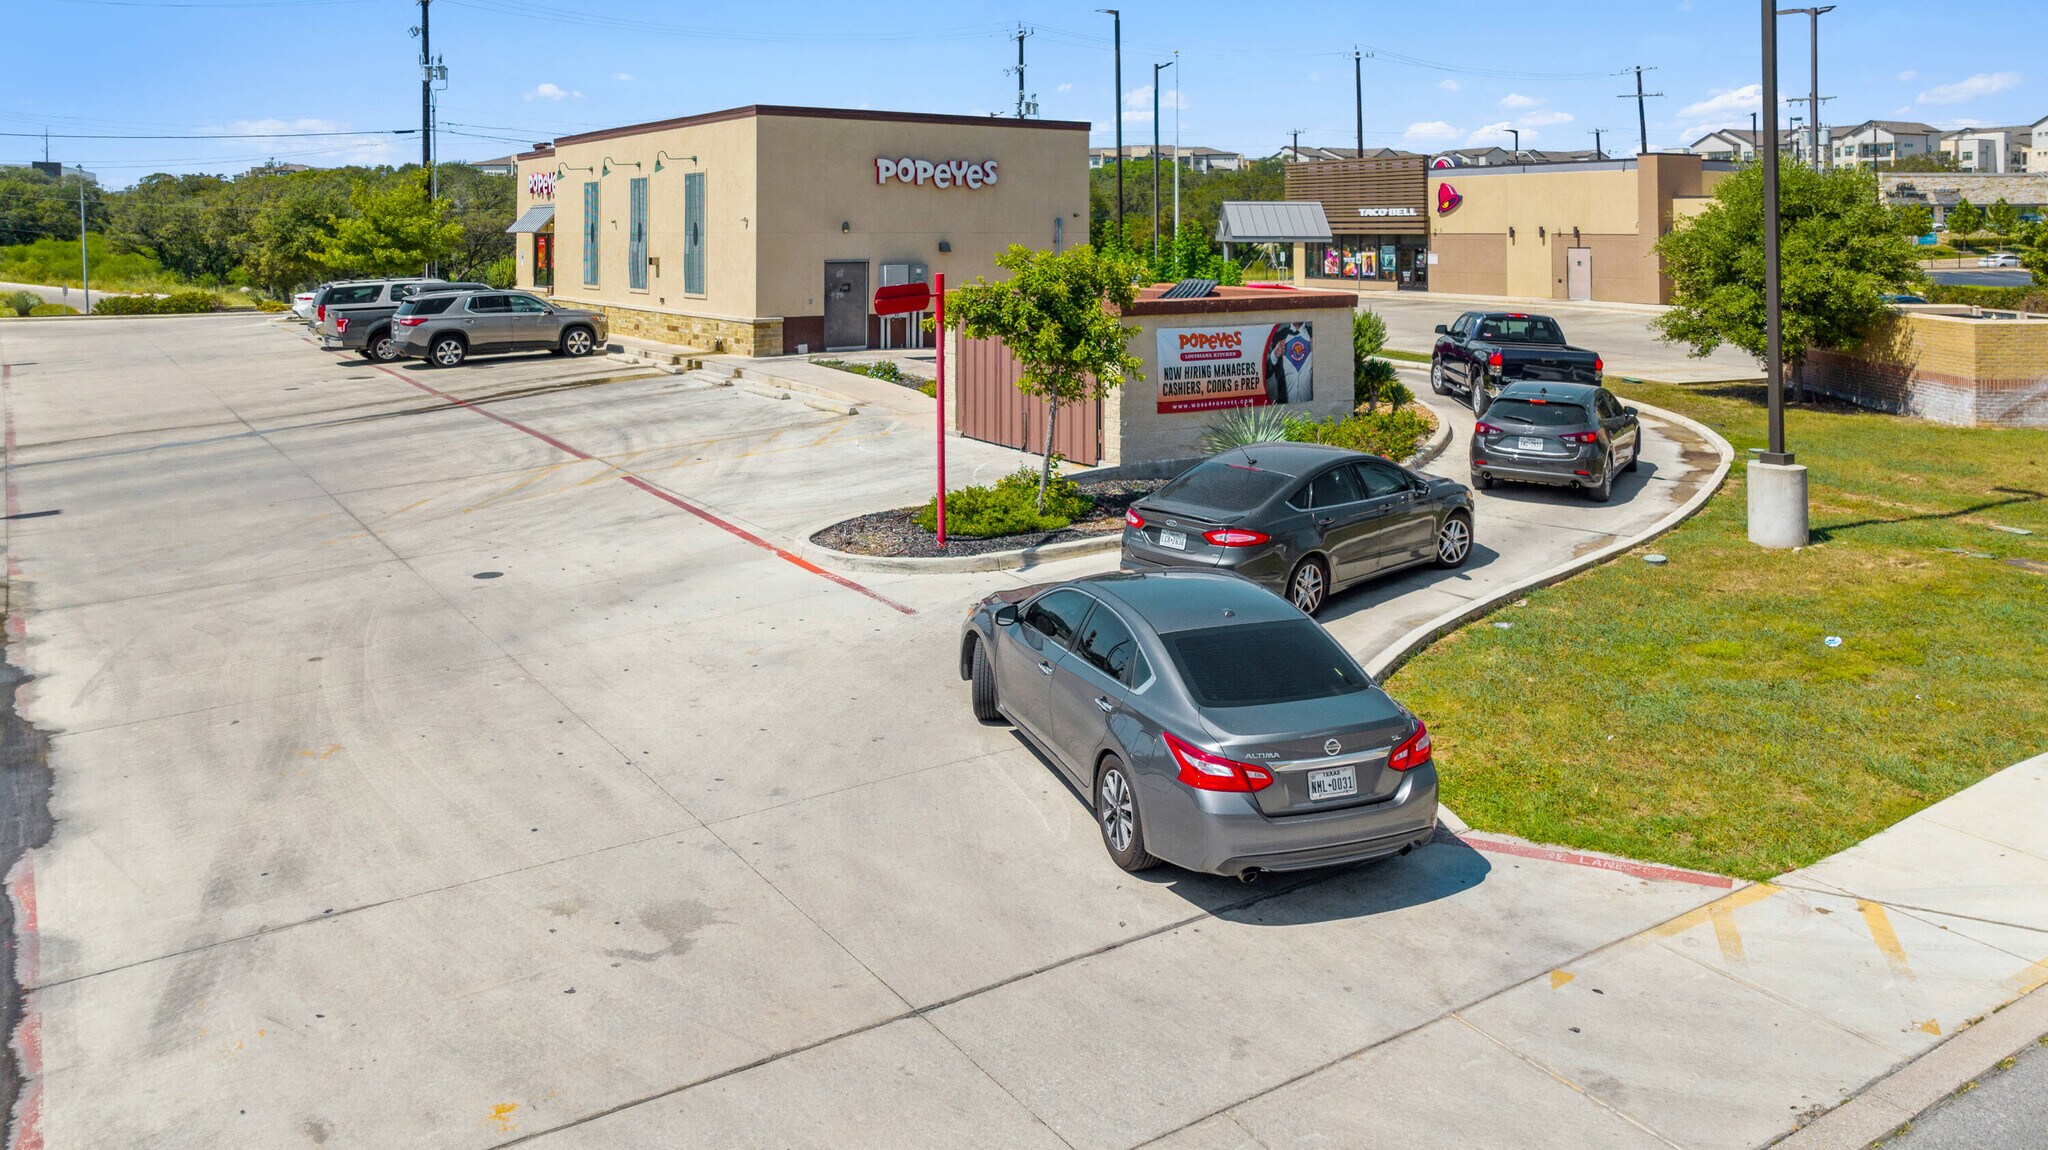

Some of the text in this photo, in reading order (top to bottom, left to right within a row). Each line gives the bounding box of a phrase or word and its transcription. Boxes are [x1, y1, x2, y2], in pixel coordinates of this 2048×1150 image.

[1358, 207, 1419, 217] TACO BELL
[1163, 362, 1259, 380] NOW HIRING MANAGERS,
[1162, 376, 1260, 396] CASHIERS, COOKS & PREP
